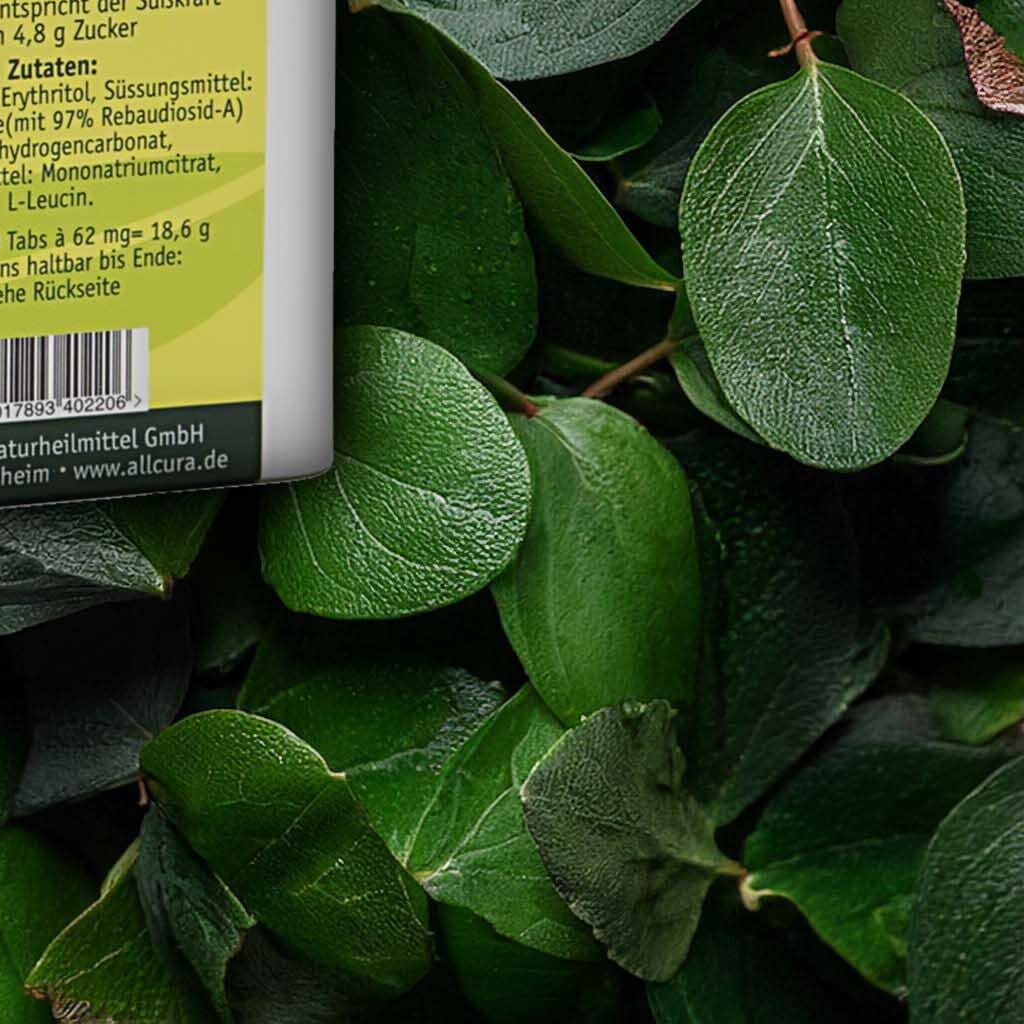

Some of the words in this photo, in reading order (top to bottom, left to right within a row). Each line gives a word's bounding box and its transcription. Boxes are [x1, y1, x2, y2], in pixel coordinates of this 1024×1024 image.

[13, 23, 46, 47] 4,8
[54, 24, 66, 48] g
[74, 17, 138, 41] Zucker
[8, 56, 98, 80] Zutaten:
[1, 82, 96, 110] Erythritol,
[104, 71, 253, 101] Süssungsmittel:
[53, 103, 94, 129] 97%
[102, 97, 244, 127] Rebaudiosid-A)
[41, 153, 221, 183] Mononatriumcitrat,
[8, 187, 94, 211] L-Leucin.
[7, 228, 48, 252] Tabs
[55, 226, 65, 248] à
[73, 226, 96, 246] 62
[151, 220, 192, 243] 18,6
[199, 220, 210, 241] g
[27, 250, 91, 277] haltbar
[99, 248, 125, 271] bis
[133, 244, 183, 269] Ende:
[33, 276, 121, 302] Rückseite
[63, 395, 126, 413] 402206
[144, 423, 204, 448] GmbH
[73, 449, 229, 480] www.allcura.de
